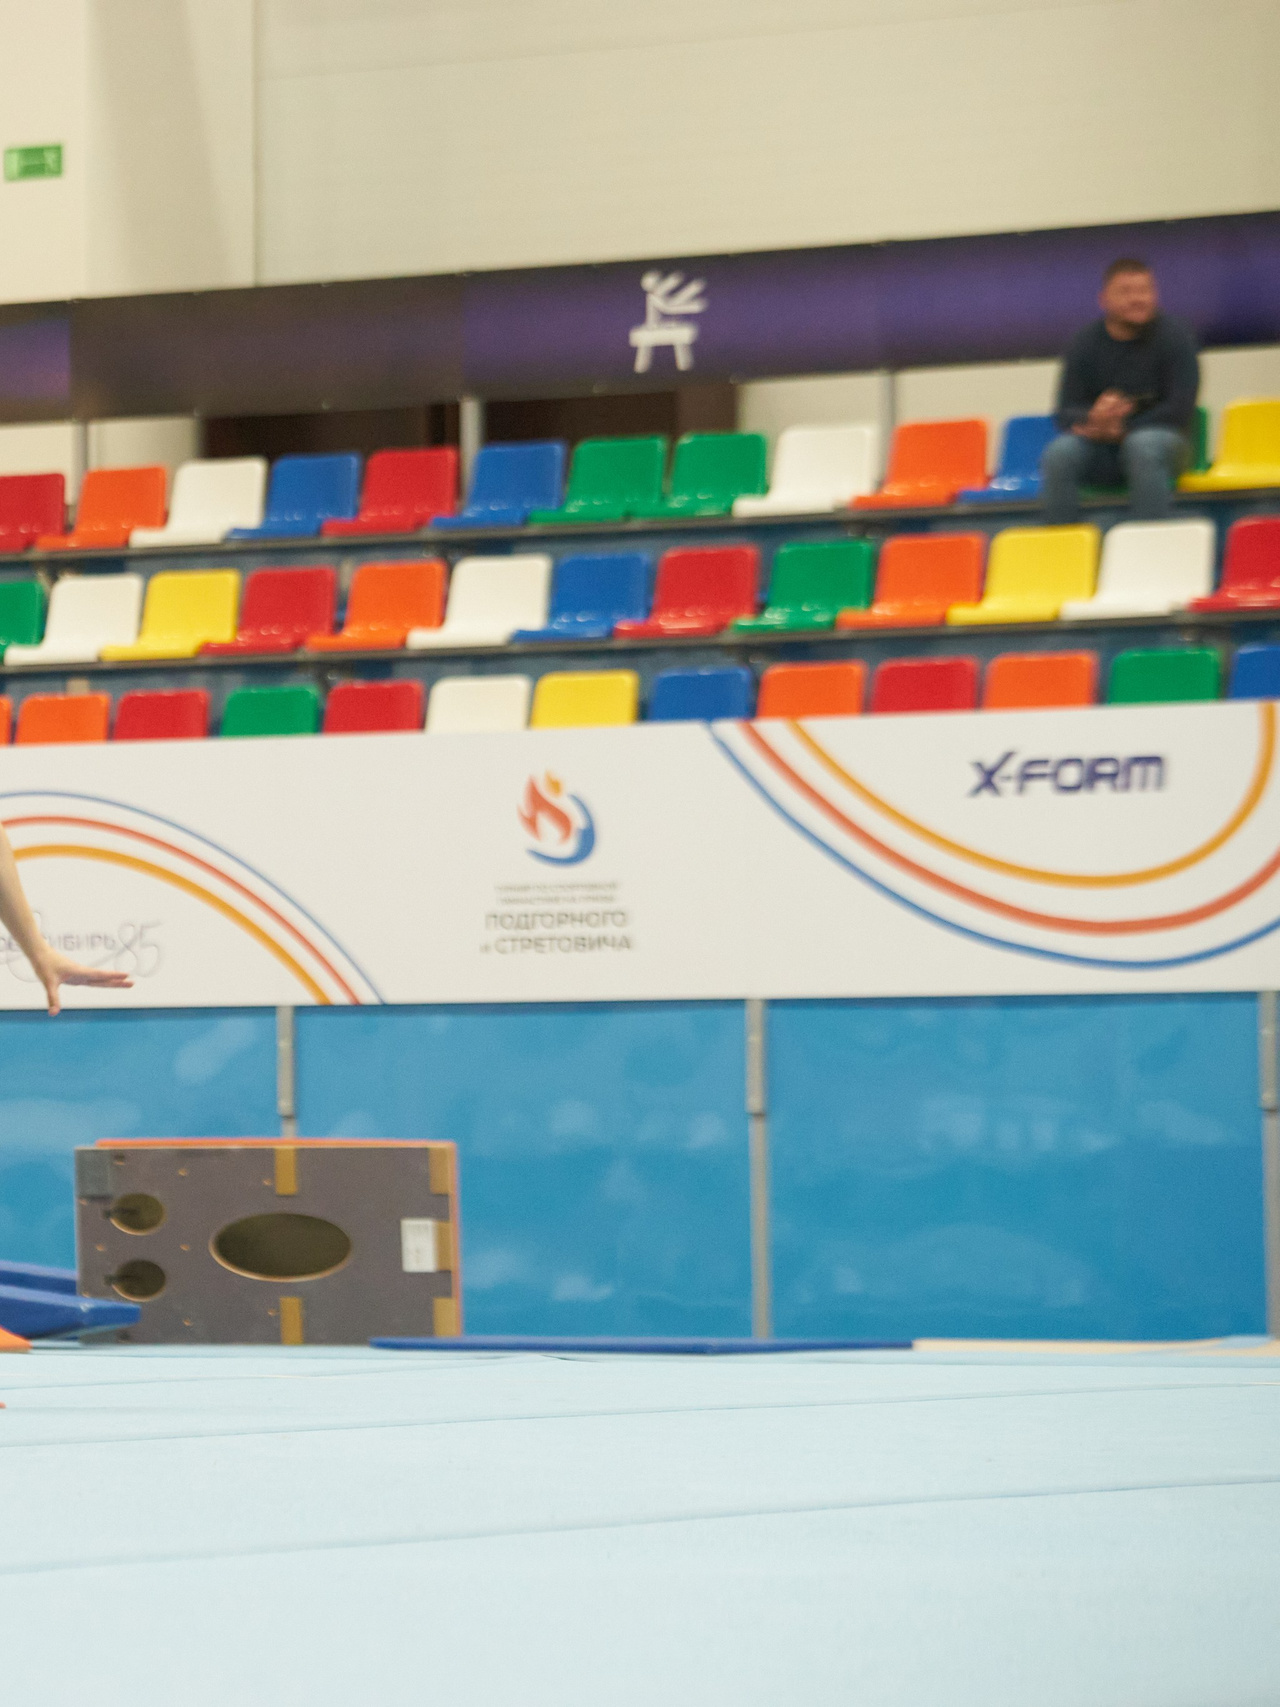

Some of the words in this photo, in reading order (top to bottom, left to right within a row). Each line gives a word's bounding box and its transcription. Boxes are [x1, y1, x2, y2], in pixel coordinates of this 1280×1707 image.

[968, 750, 1164, 797] X-FORM
[484, 912, 627, 930] ПОДГОРНОГО
[494, 936, 631, 954] СТРЕТОВИЧА
